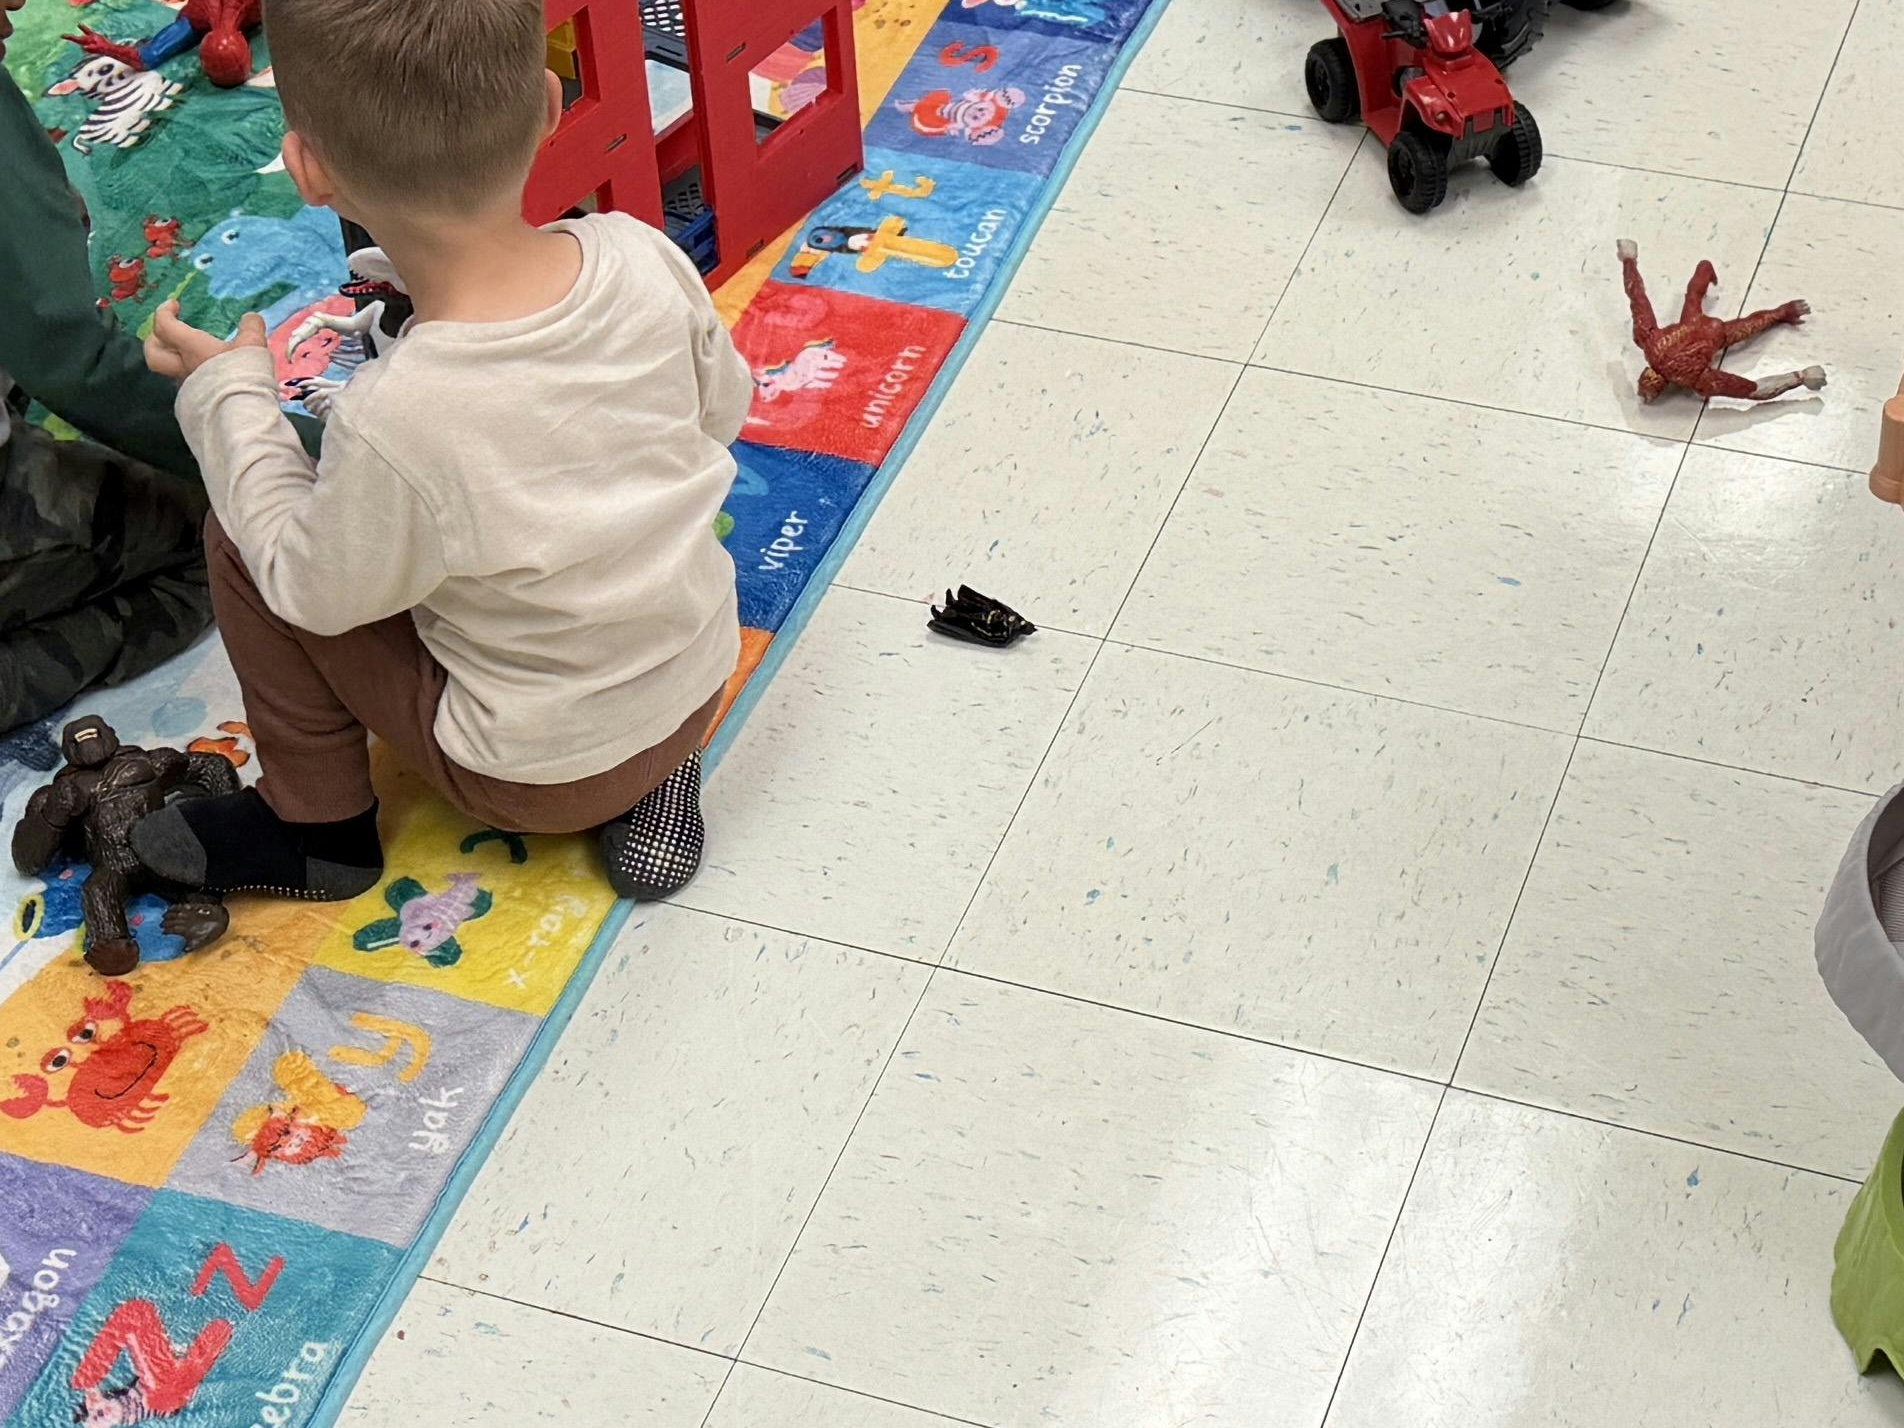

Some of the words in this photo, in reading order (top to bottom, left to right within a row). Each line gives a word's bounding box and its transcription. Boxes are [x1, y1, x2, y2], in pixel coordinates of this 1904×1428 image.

[1019, 64, 1083, 145] scorpion
[943, 209, 1007, 279] toucan
[862, 345, 927, 429] unicorn
[759, 510, 809, 572] viper
[408, 1086, 465, 1154] yak
